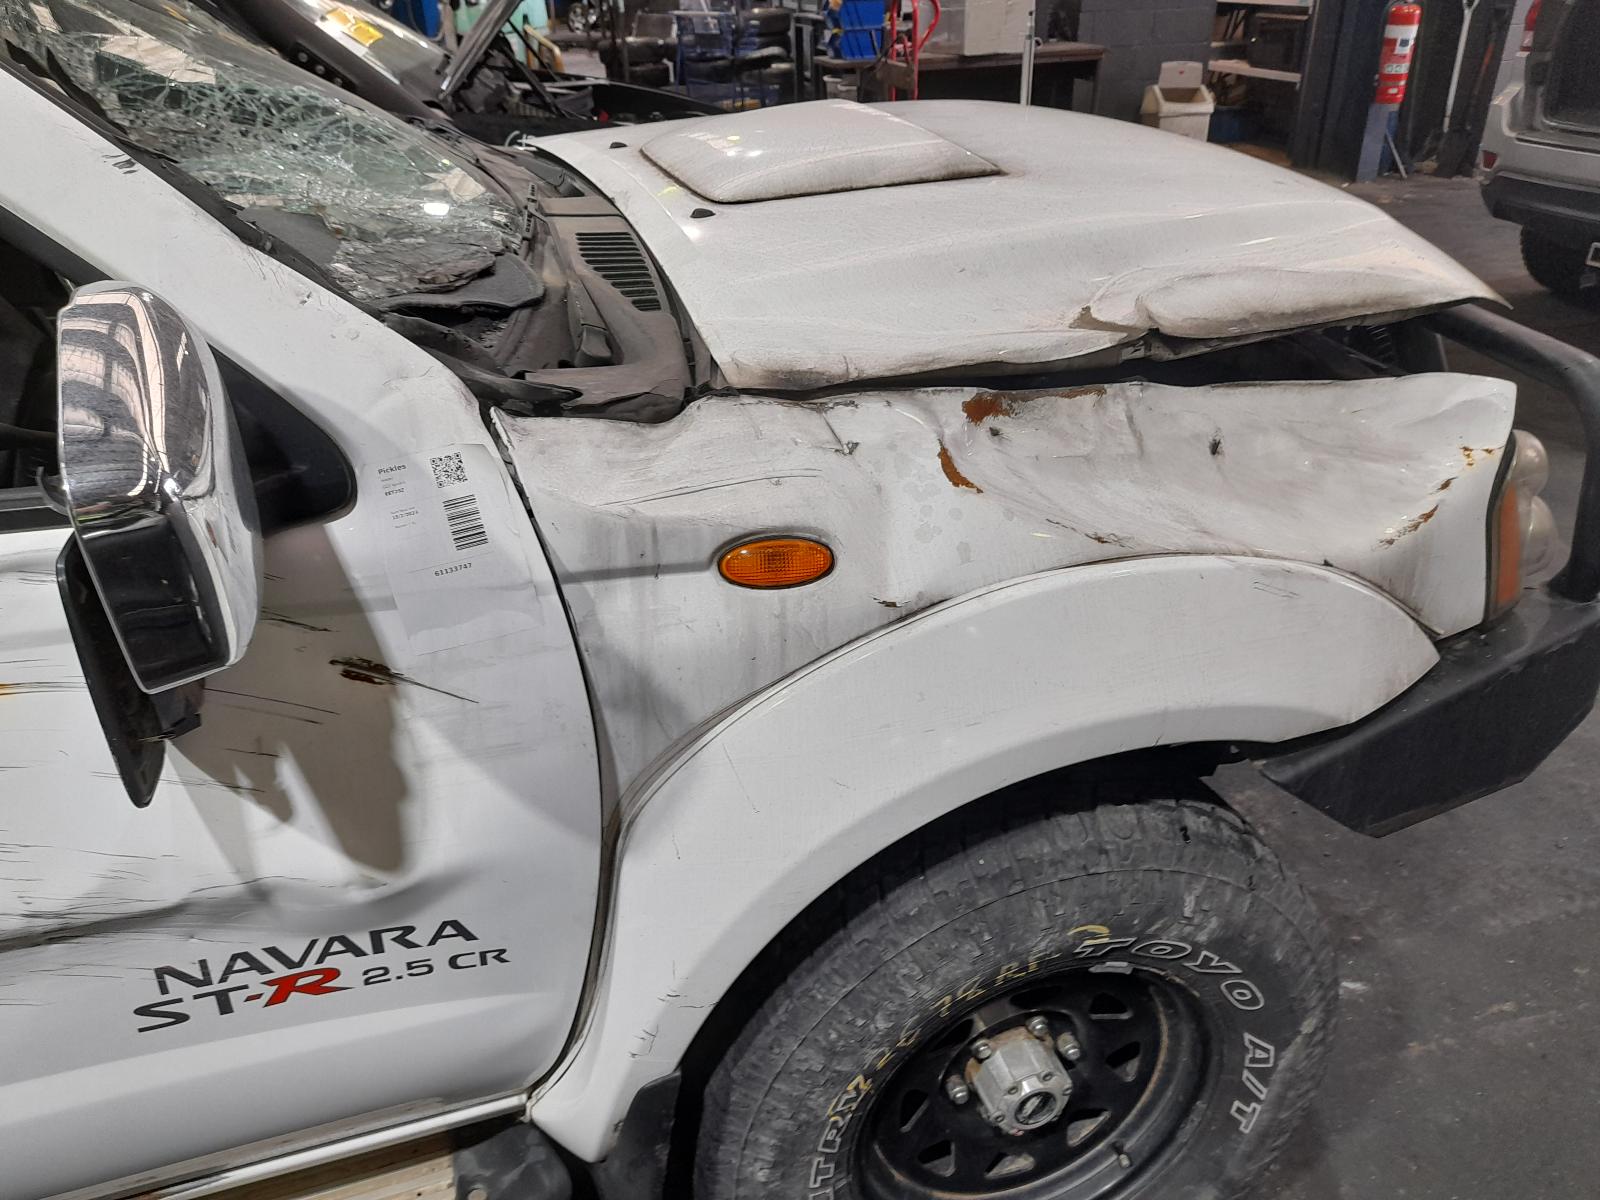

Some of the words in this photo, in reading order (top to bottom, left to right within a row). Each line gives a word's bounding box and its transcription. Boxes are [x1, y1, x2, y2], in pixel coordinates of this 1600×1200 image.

[378, 464, 407, 475] Pickles
[434, 562, 472, 577] 61133747
[133, 967, 355, 1033] ST-R
[362, 958, 434, 986] 2.5
[448, 948, 511, 970] CR
[153, 919, 479, 995] NAVARA
[1073, 937, 1265, 1010] TOYO
[1230, 1032, 1275, 1134] A/T
